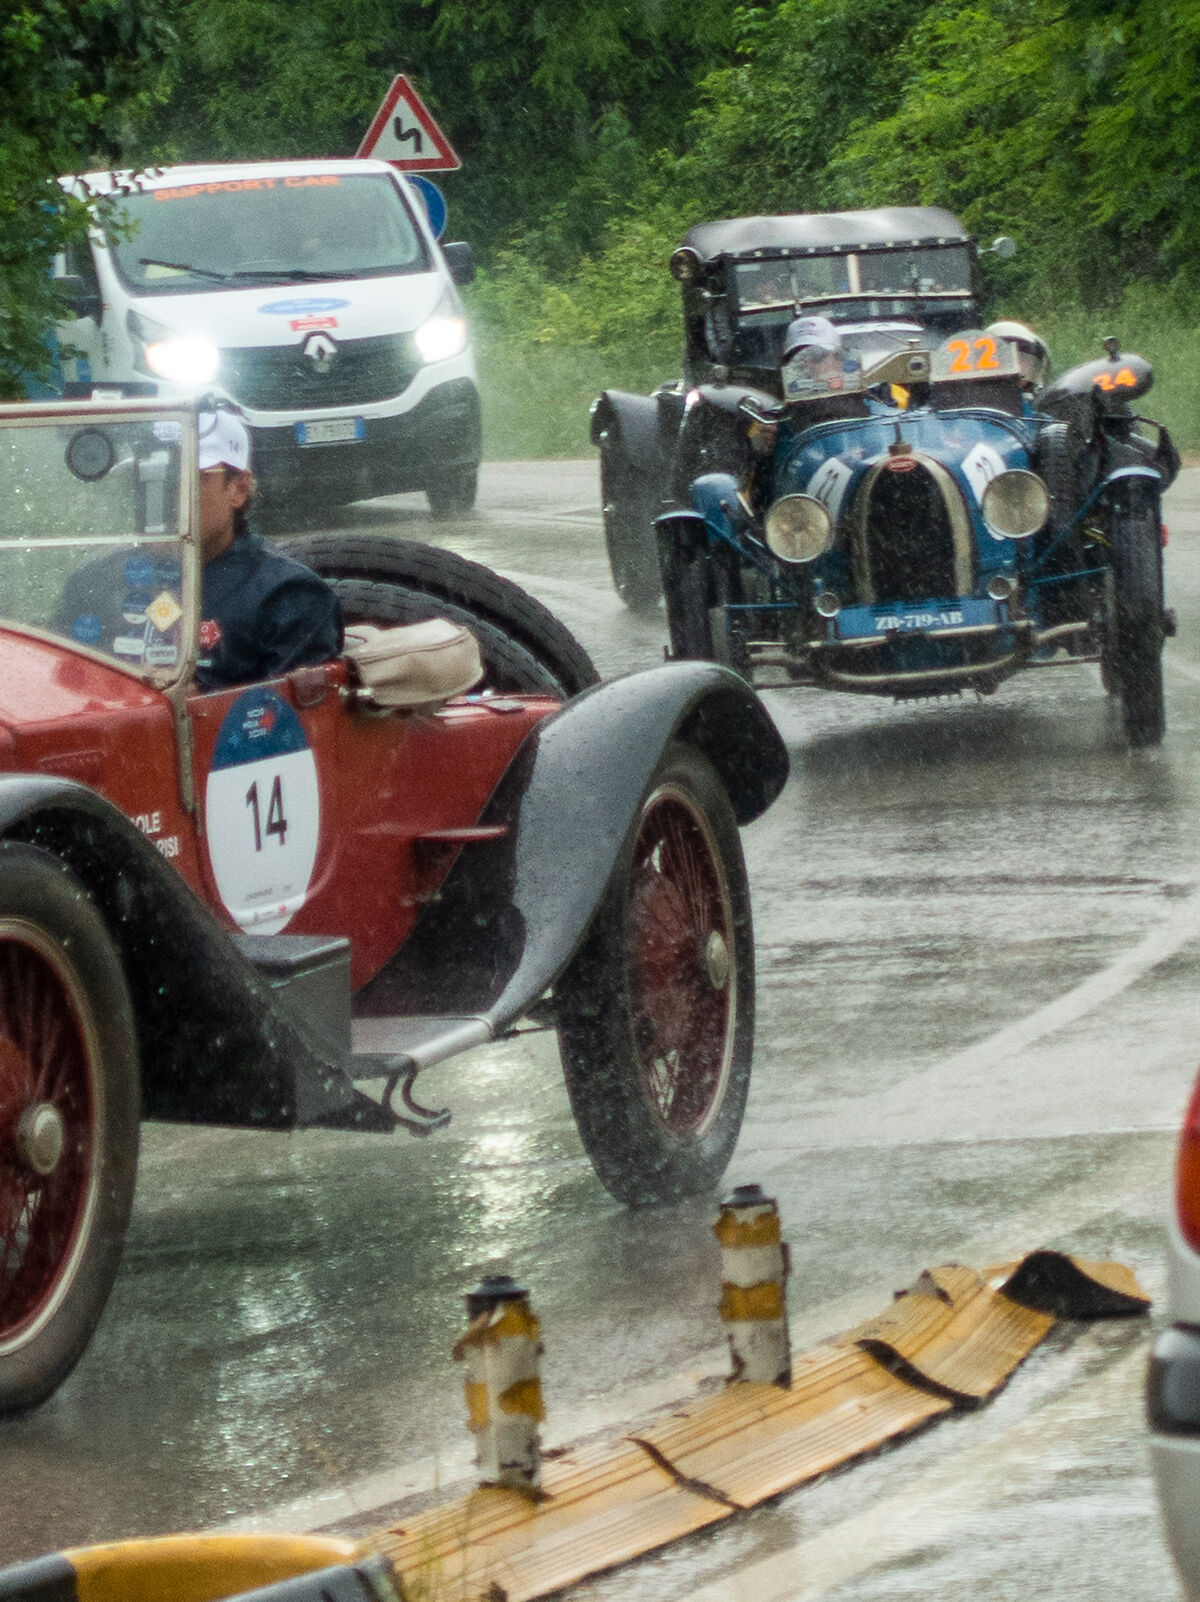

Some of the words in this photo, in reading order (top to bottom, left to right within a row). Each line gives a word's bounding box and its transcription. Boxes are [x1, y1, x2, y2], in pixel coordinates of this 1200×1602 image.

[153, 176, 277, 202] SUPPORT
[283, 174, 341, 188] CAR
[948, 337, 1000, 374] 22
[130, 811, 162, 835] OLE
[246, 774, 288, 853] 14
